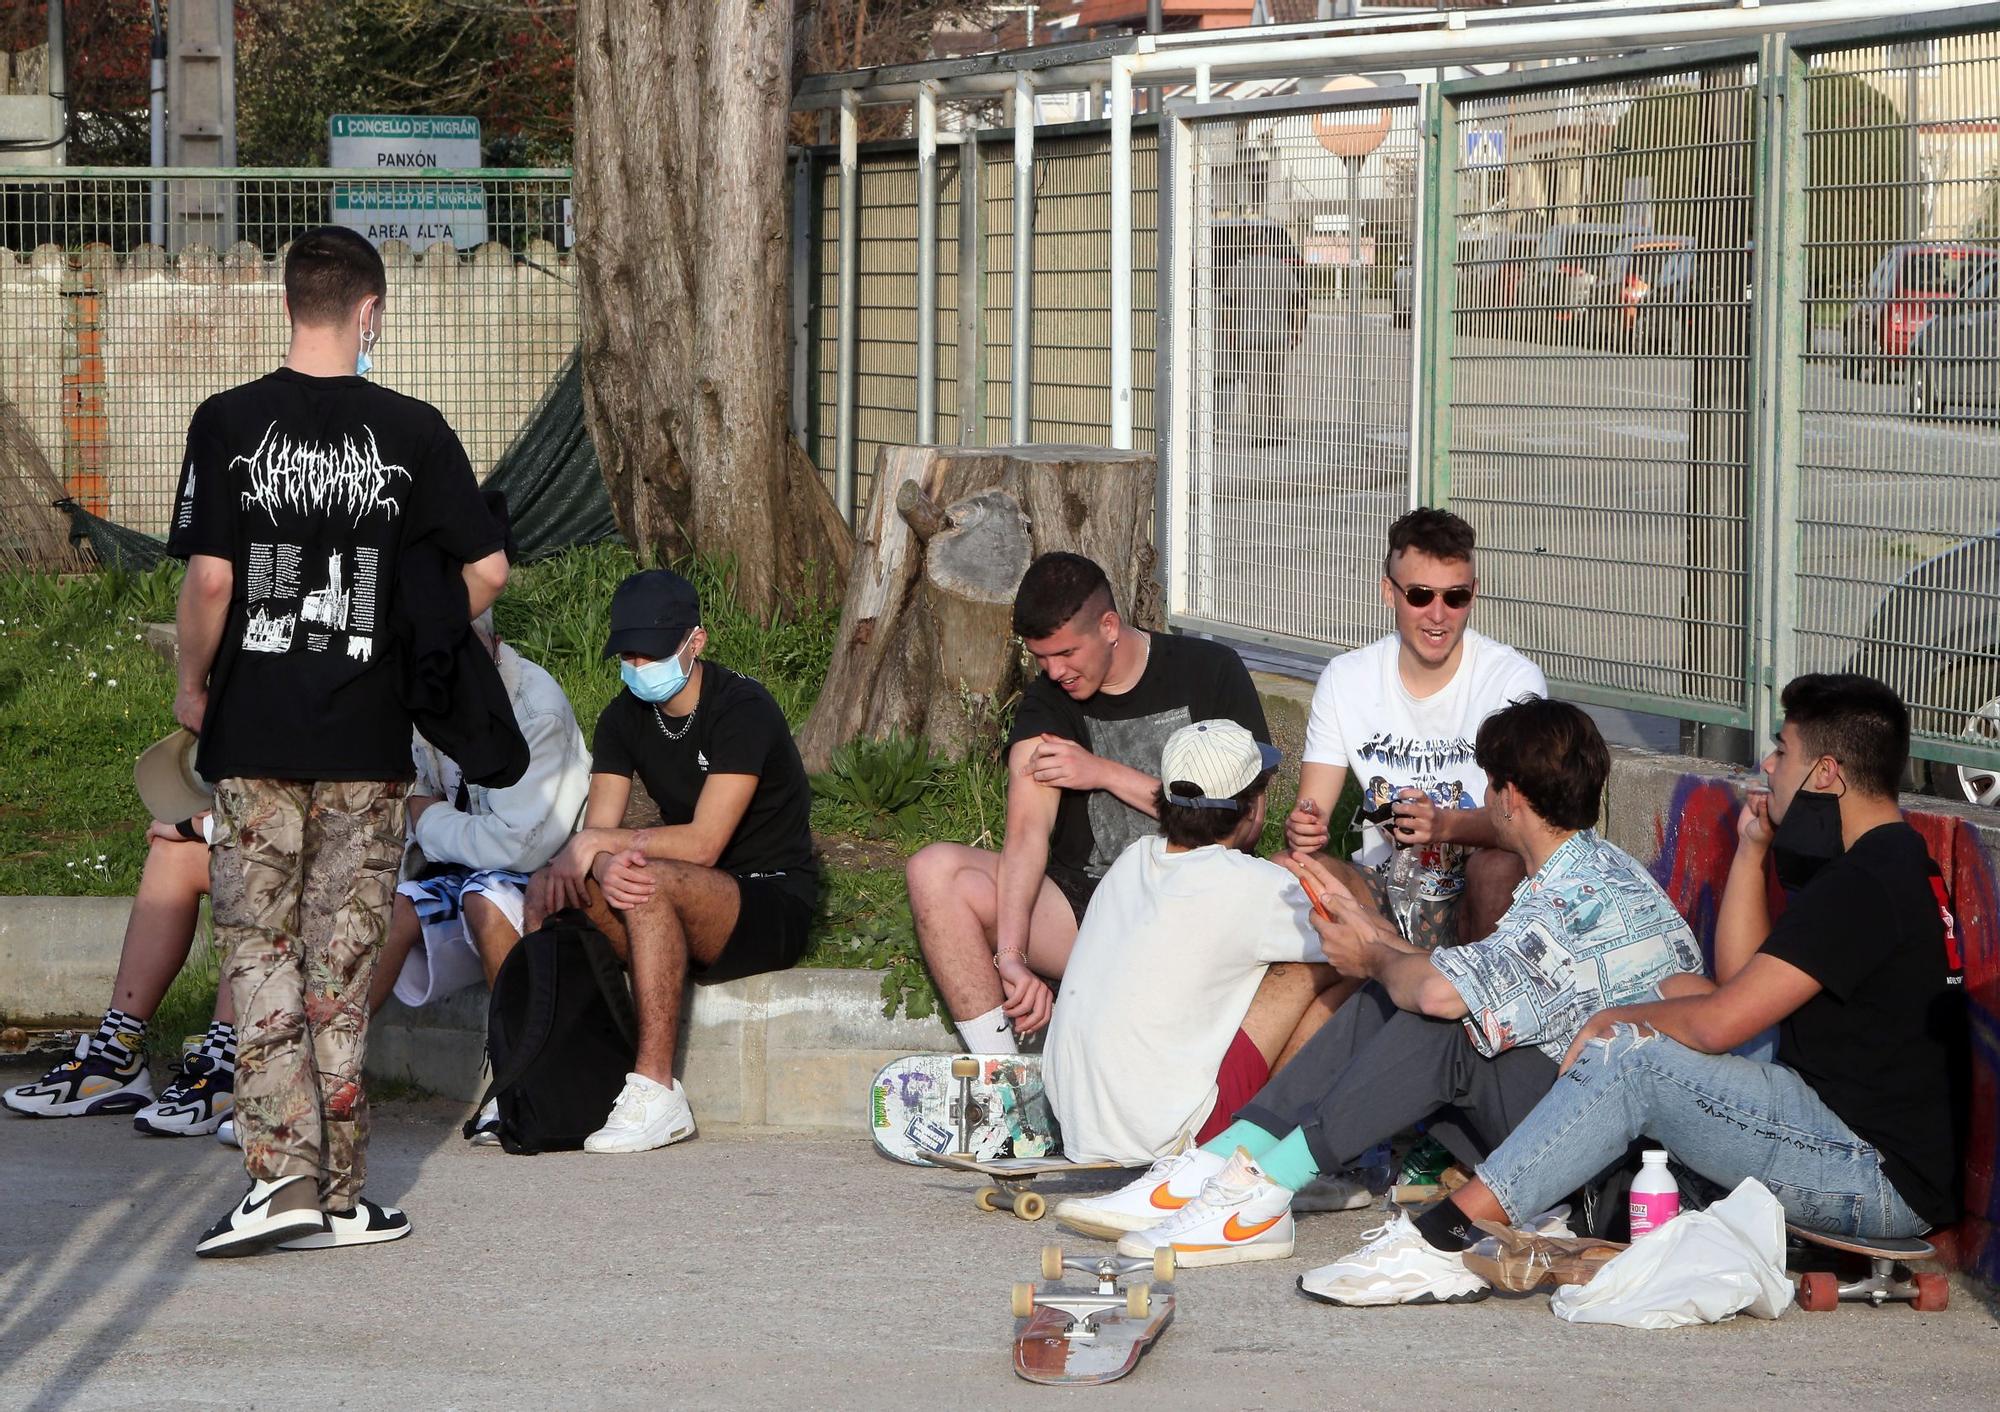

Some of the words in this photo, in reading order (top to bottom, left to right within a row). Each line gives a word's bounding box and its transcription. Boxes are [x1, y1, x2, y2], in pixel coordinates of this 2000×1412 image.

[348, 121, 411, 135] CONCELLO
[413, 121, 430, 135] DE
[432, 119, 476, 136] NIGRÁN
[377, 150, 437, 168] PANXÓN
[350, 191, 415, 205] CONCELLO
[417, 192, 433, 206] DE
[436, 189, 482, 206] NIGRÁN
[368, 224, 408, 239] AREA
[416, 224, 454, 239] ALTA
[1581, 942, 1606, 960] AVALON
[1609, 938, 1623, 949] AIR
[1626, 925, 1663, 943] TRANSPORT
